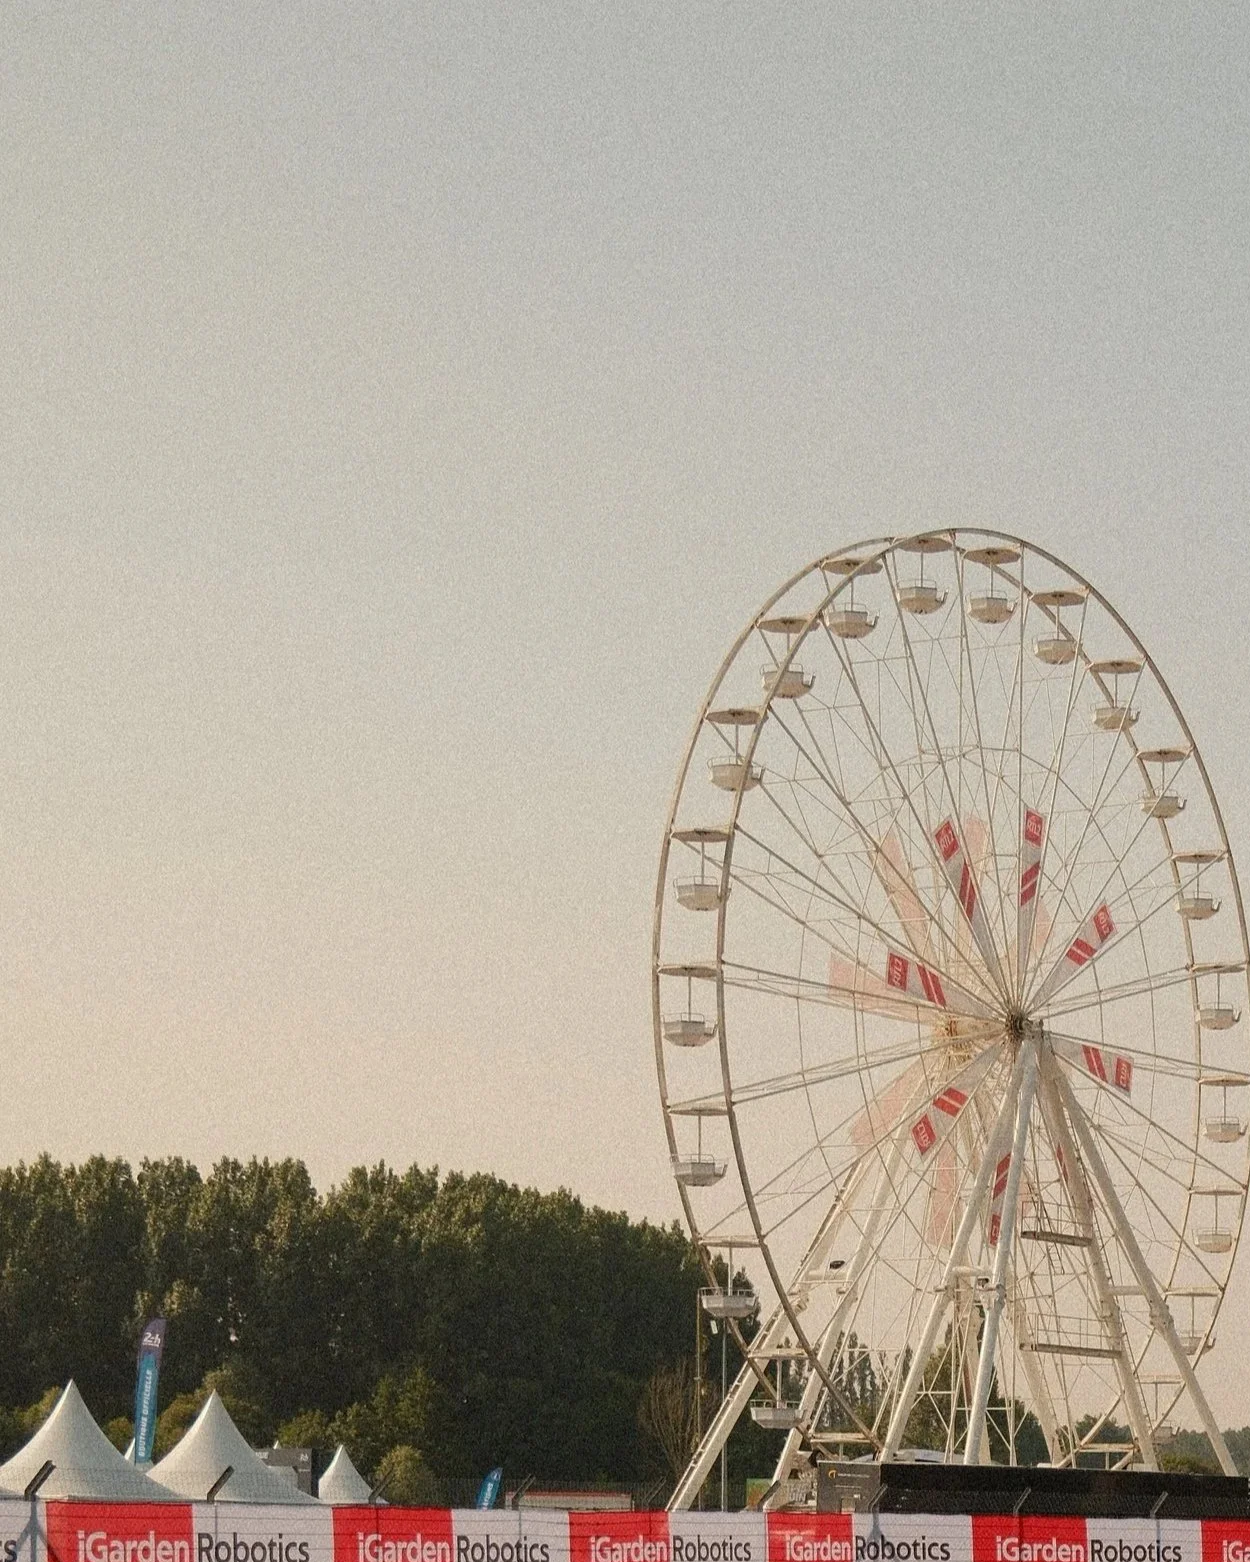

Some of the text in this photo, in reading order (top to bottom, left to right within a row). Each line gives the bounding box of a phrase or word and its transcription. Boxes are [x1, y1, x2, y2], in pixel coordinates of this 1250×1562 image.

[672, 1534, 751, 1562] Robotics
[785, 1533, 951, 1562] iGarden Robotics
[996, 1536, 1085, 1562] iGarden
